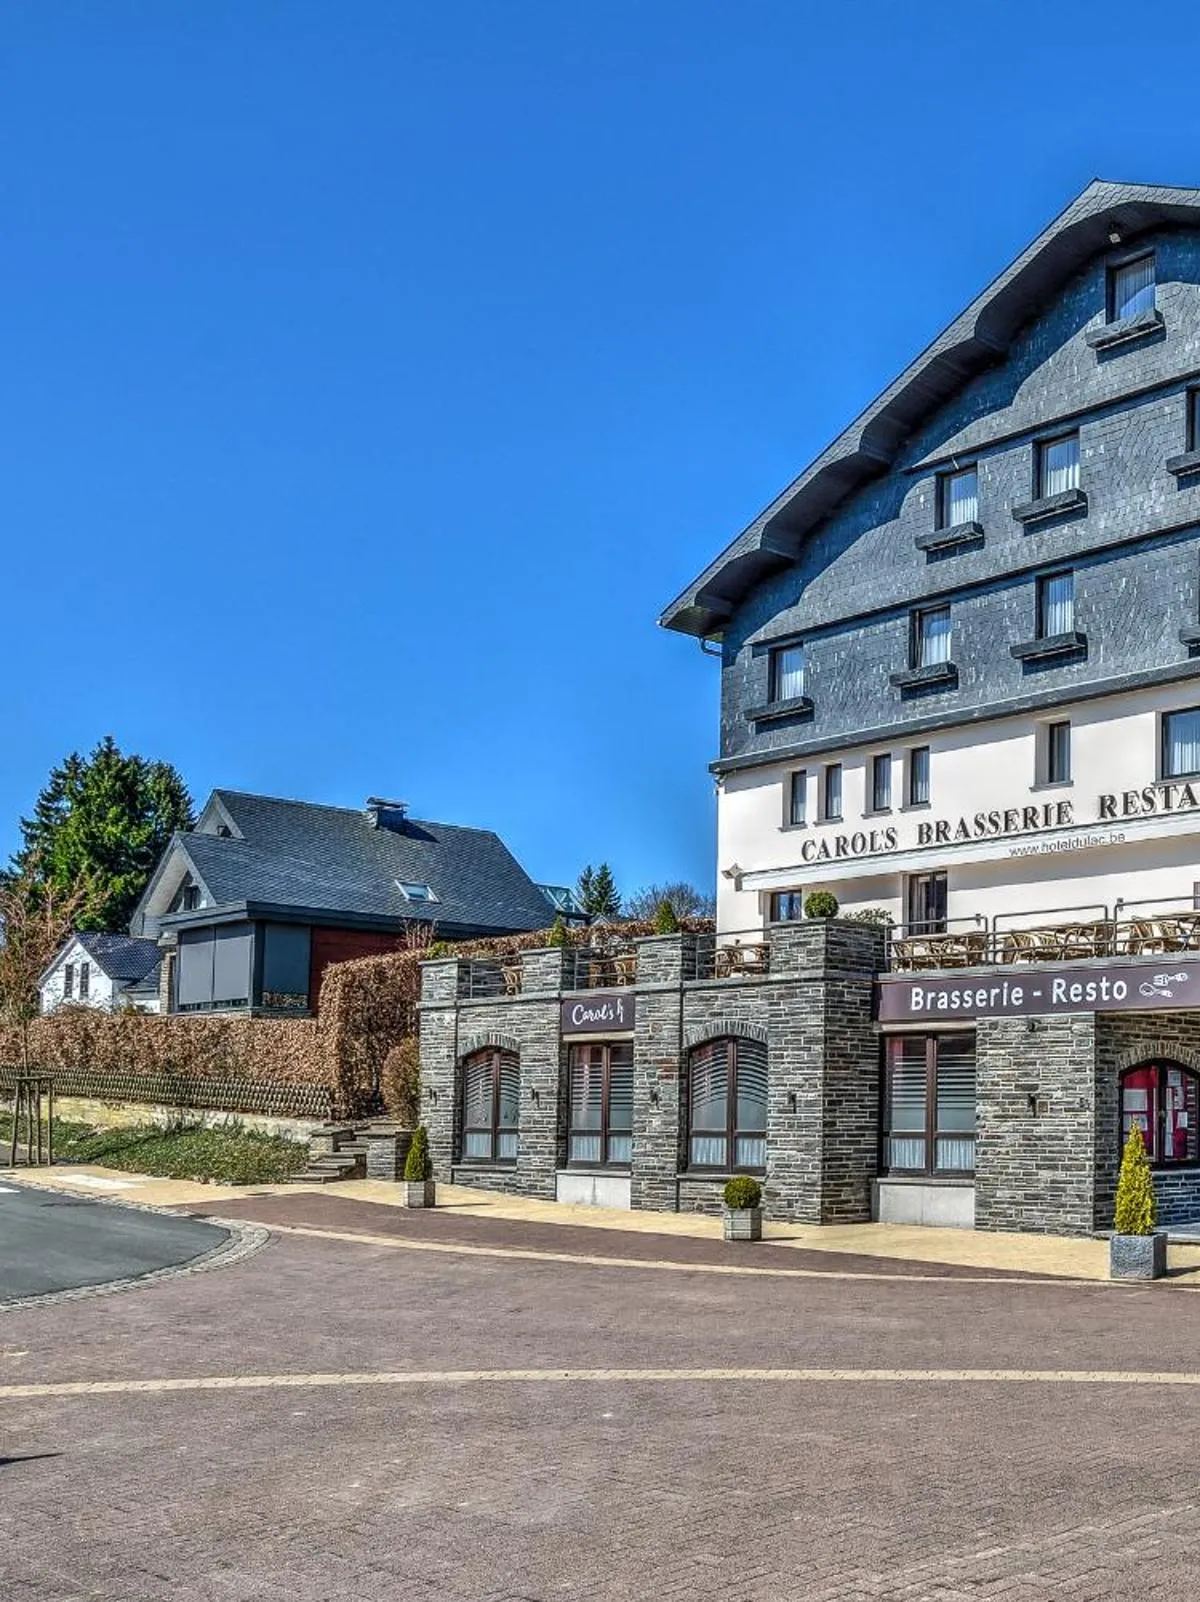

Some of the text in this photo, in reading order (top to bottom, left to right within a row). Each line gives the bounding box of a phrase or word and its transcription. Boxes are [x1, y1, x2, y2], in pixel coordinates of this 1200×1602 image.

[801, 826, 898, 862] CAROL'S
[917, 801, 1075, 845] BRASSERIE
[910, 981, 1024, 1011] Brasserie
[1051, 976, 1128, 1005] Resto
[572, 1003, 614, 1025] Carol's
